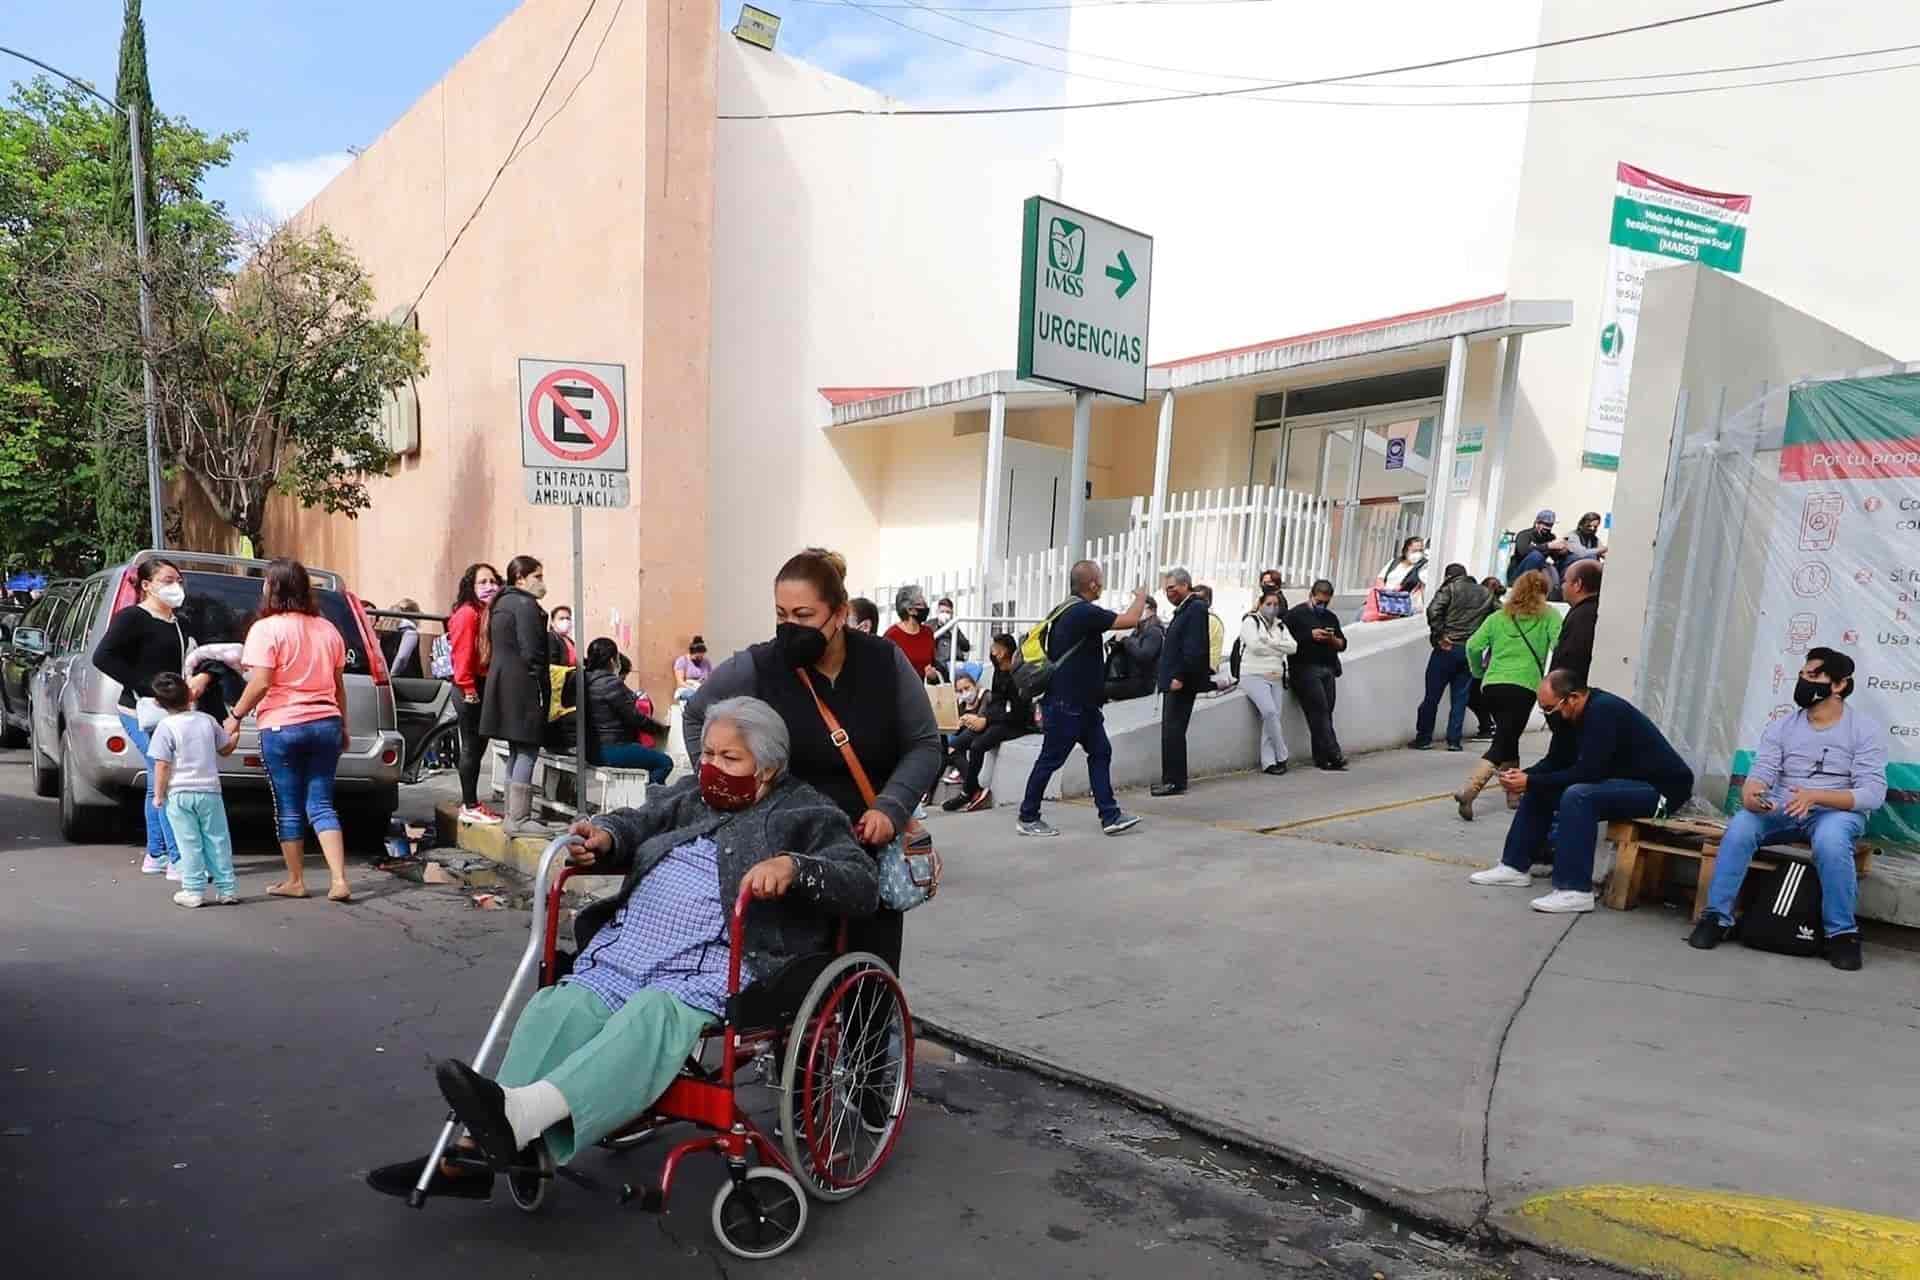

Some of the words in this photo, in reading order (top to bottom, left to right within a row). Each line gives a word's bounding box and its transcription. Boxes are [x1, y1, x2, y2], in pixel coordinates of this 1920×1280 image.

[1046, 267, 1083, 298] IMSS
[1039, 311, 1141, 365] URGENCIAS
[553, 385, 594, 444] E
[1812, 453, 1840, 467] Por
[1847, 454, 1865, 465] tu
[1872, 451, 1920, 473] prop
[536, 471, 595, 487] ENTRADA
[600, 473, 615, 488] DE
[535, 489, 617, 507] AMBULANCIA
[1878, 632, 1910, 646] Usa
